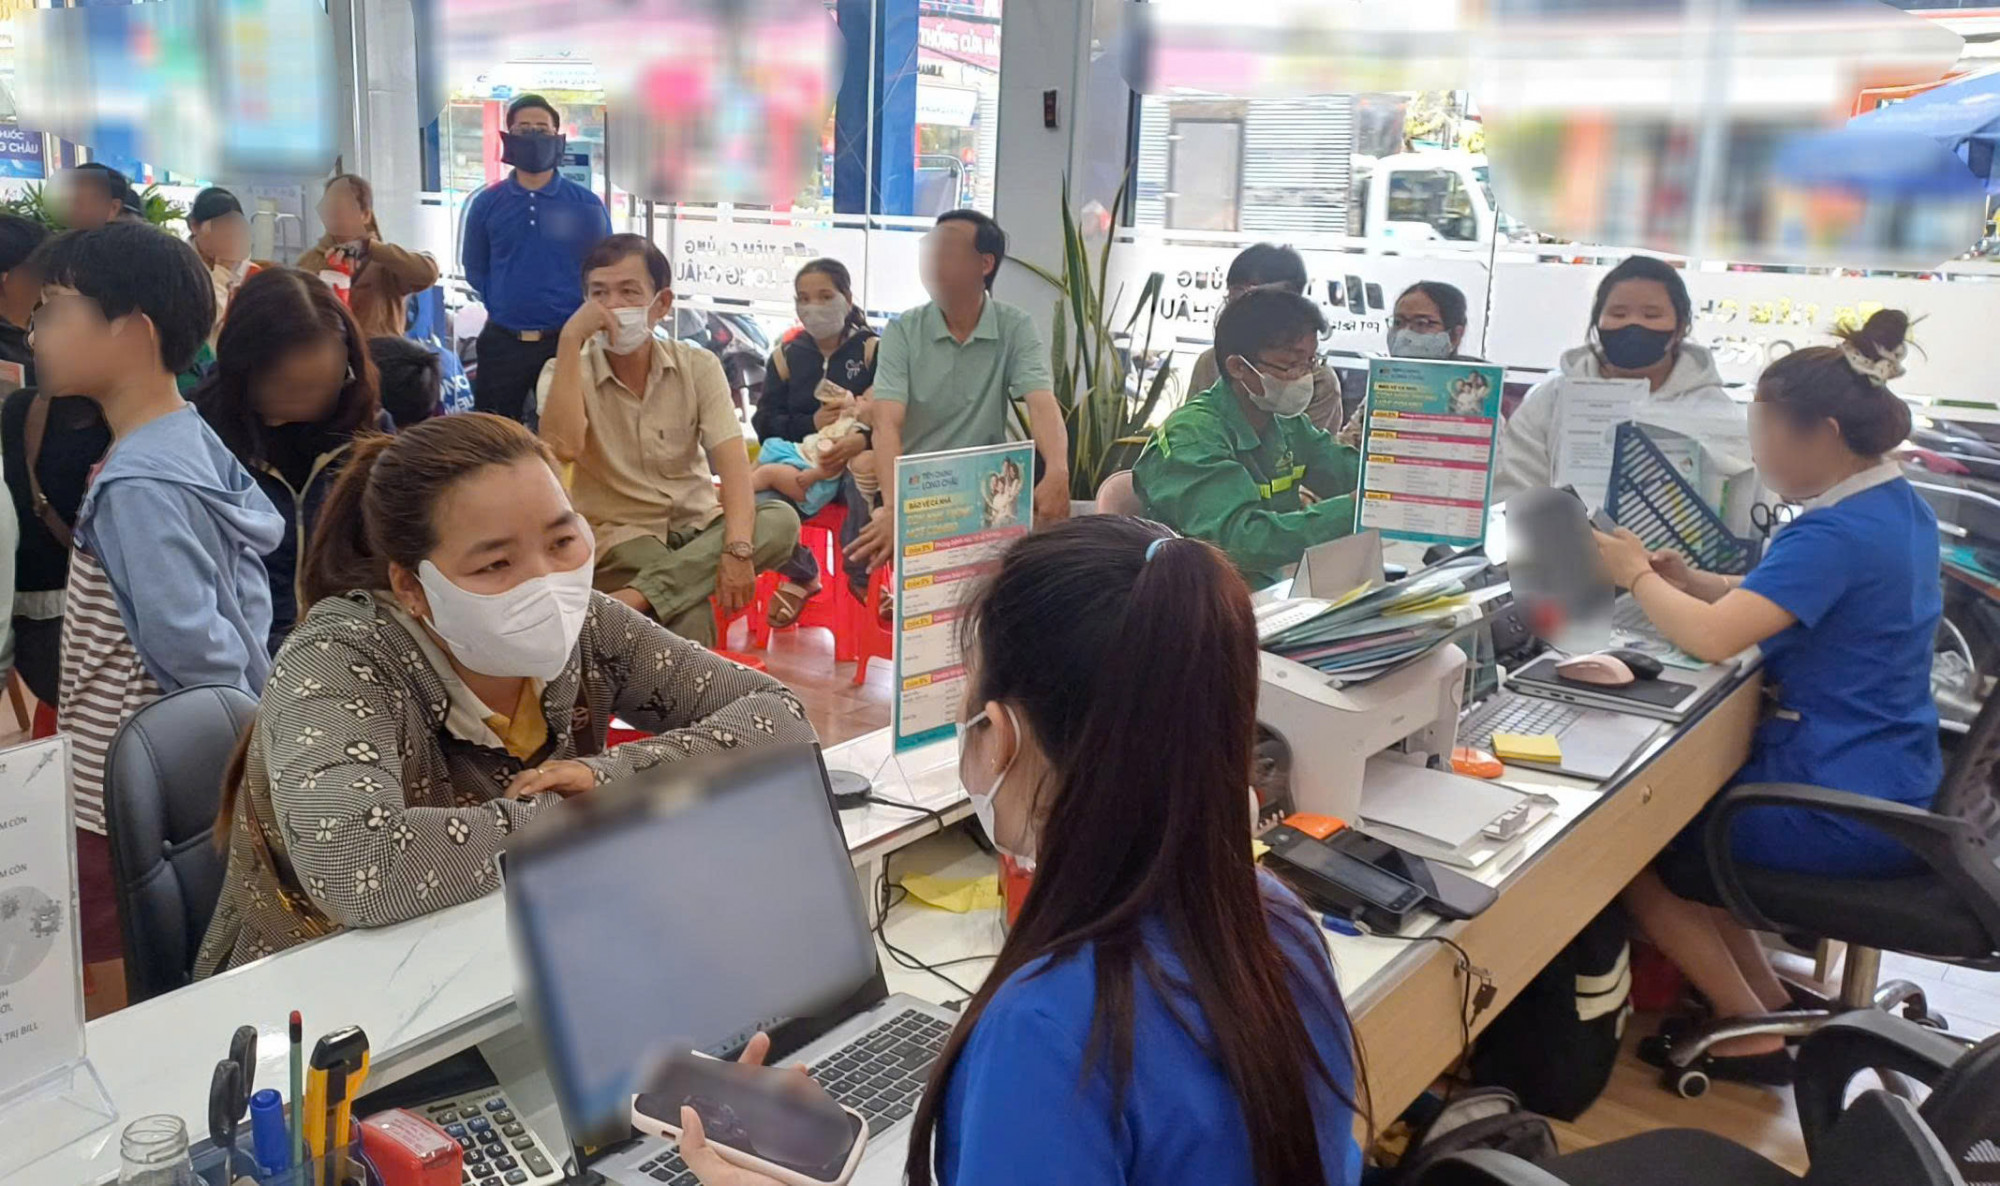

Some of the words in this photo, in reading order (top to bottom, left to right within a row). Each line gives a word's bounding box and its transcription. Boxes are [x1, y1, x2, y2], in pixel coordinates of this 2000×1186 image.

[8, 141, 38, 154] CHÂU
[9, 816, 27, 828] CÒN
[9, 863, 27, 876] CÒN
[21, 1022, 38, 1035] BILL
